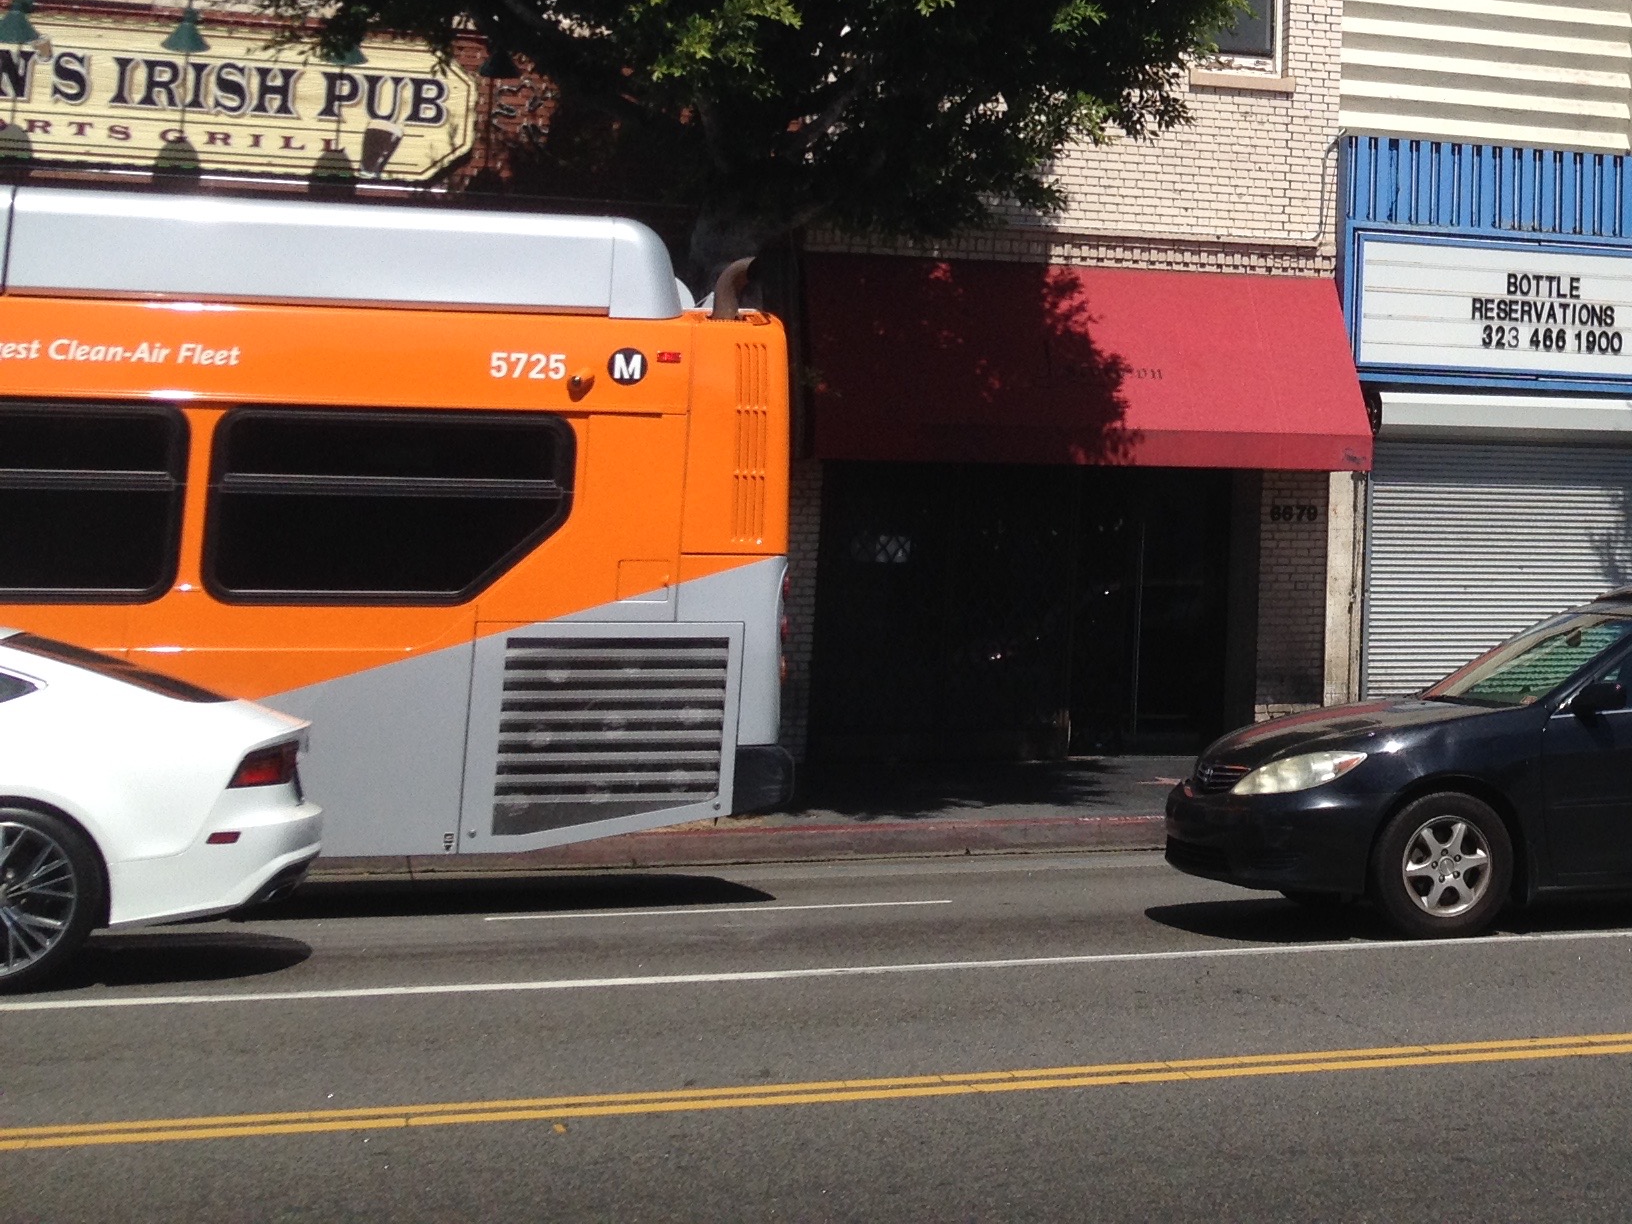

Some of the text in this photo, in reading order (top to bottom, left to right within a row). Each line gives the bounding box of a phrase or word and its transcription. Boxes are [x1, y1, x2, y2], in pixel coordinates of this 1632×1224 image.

[108, 57, 300, 117] IRISH
[317, 72, 448, 125] PUB
[159, 129, 346, 153] GRILL
[1507, 273, 1580, 299] BOTTLE
[1471, 298, 1615, 327] RESERVATIONS
[48, 339, 170, 364] Clean-Air
[176, 343, 241, 366] Fleet
[1482, 325, 1623, 355] 323 466 1900
[490, 352, 566, 380] 5725
[613, 353, 642, 380] M
